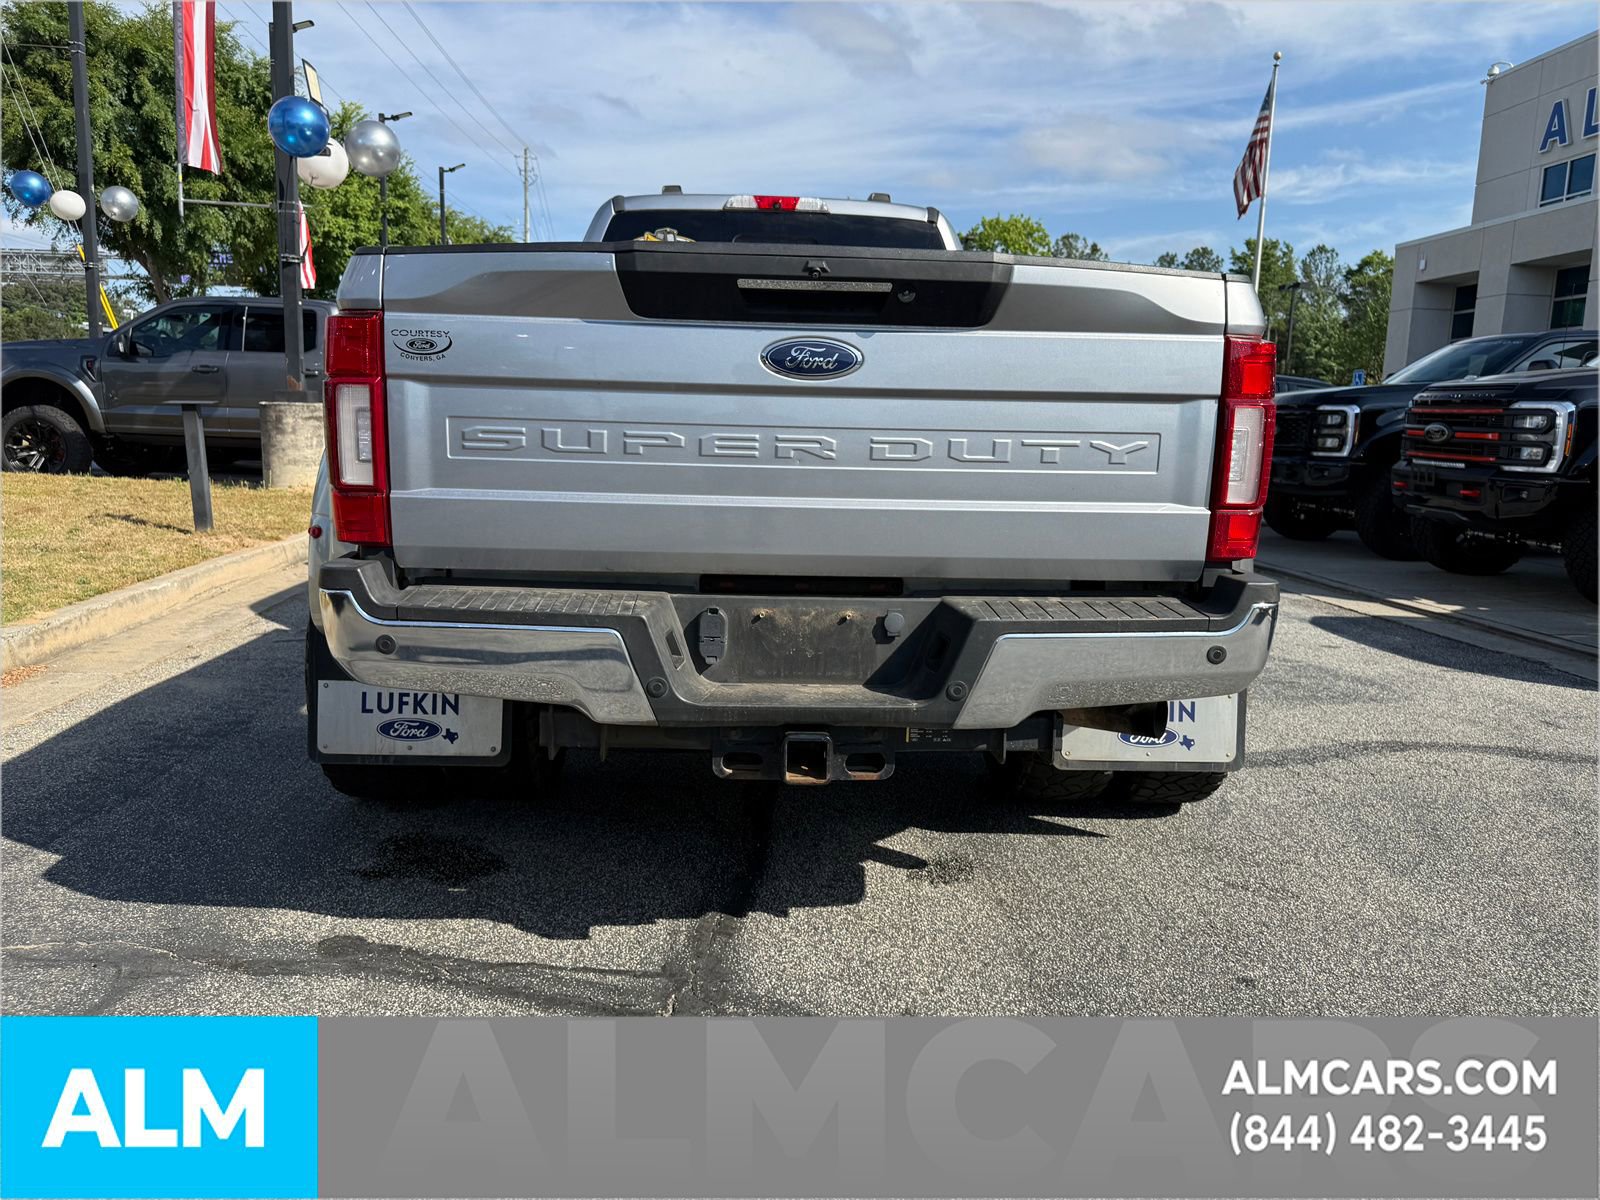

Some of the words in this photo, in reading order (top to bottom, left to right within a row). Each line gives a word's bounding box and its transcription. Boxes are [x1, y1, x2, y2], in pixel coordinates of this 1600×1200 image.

[390, 328, 450, 338] COURTESY
[436, 353, 446, 361] GA
[784, 345, 840, 370] Ford
[461, 425, 837, 461] SUPER
[869, 437, 1149, 465] DUTY
[361, 691, 460, 716] LUFKIN
[390, 721, 429, 737] Ford
